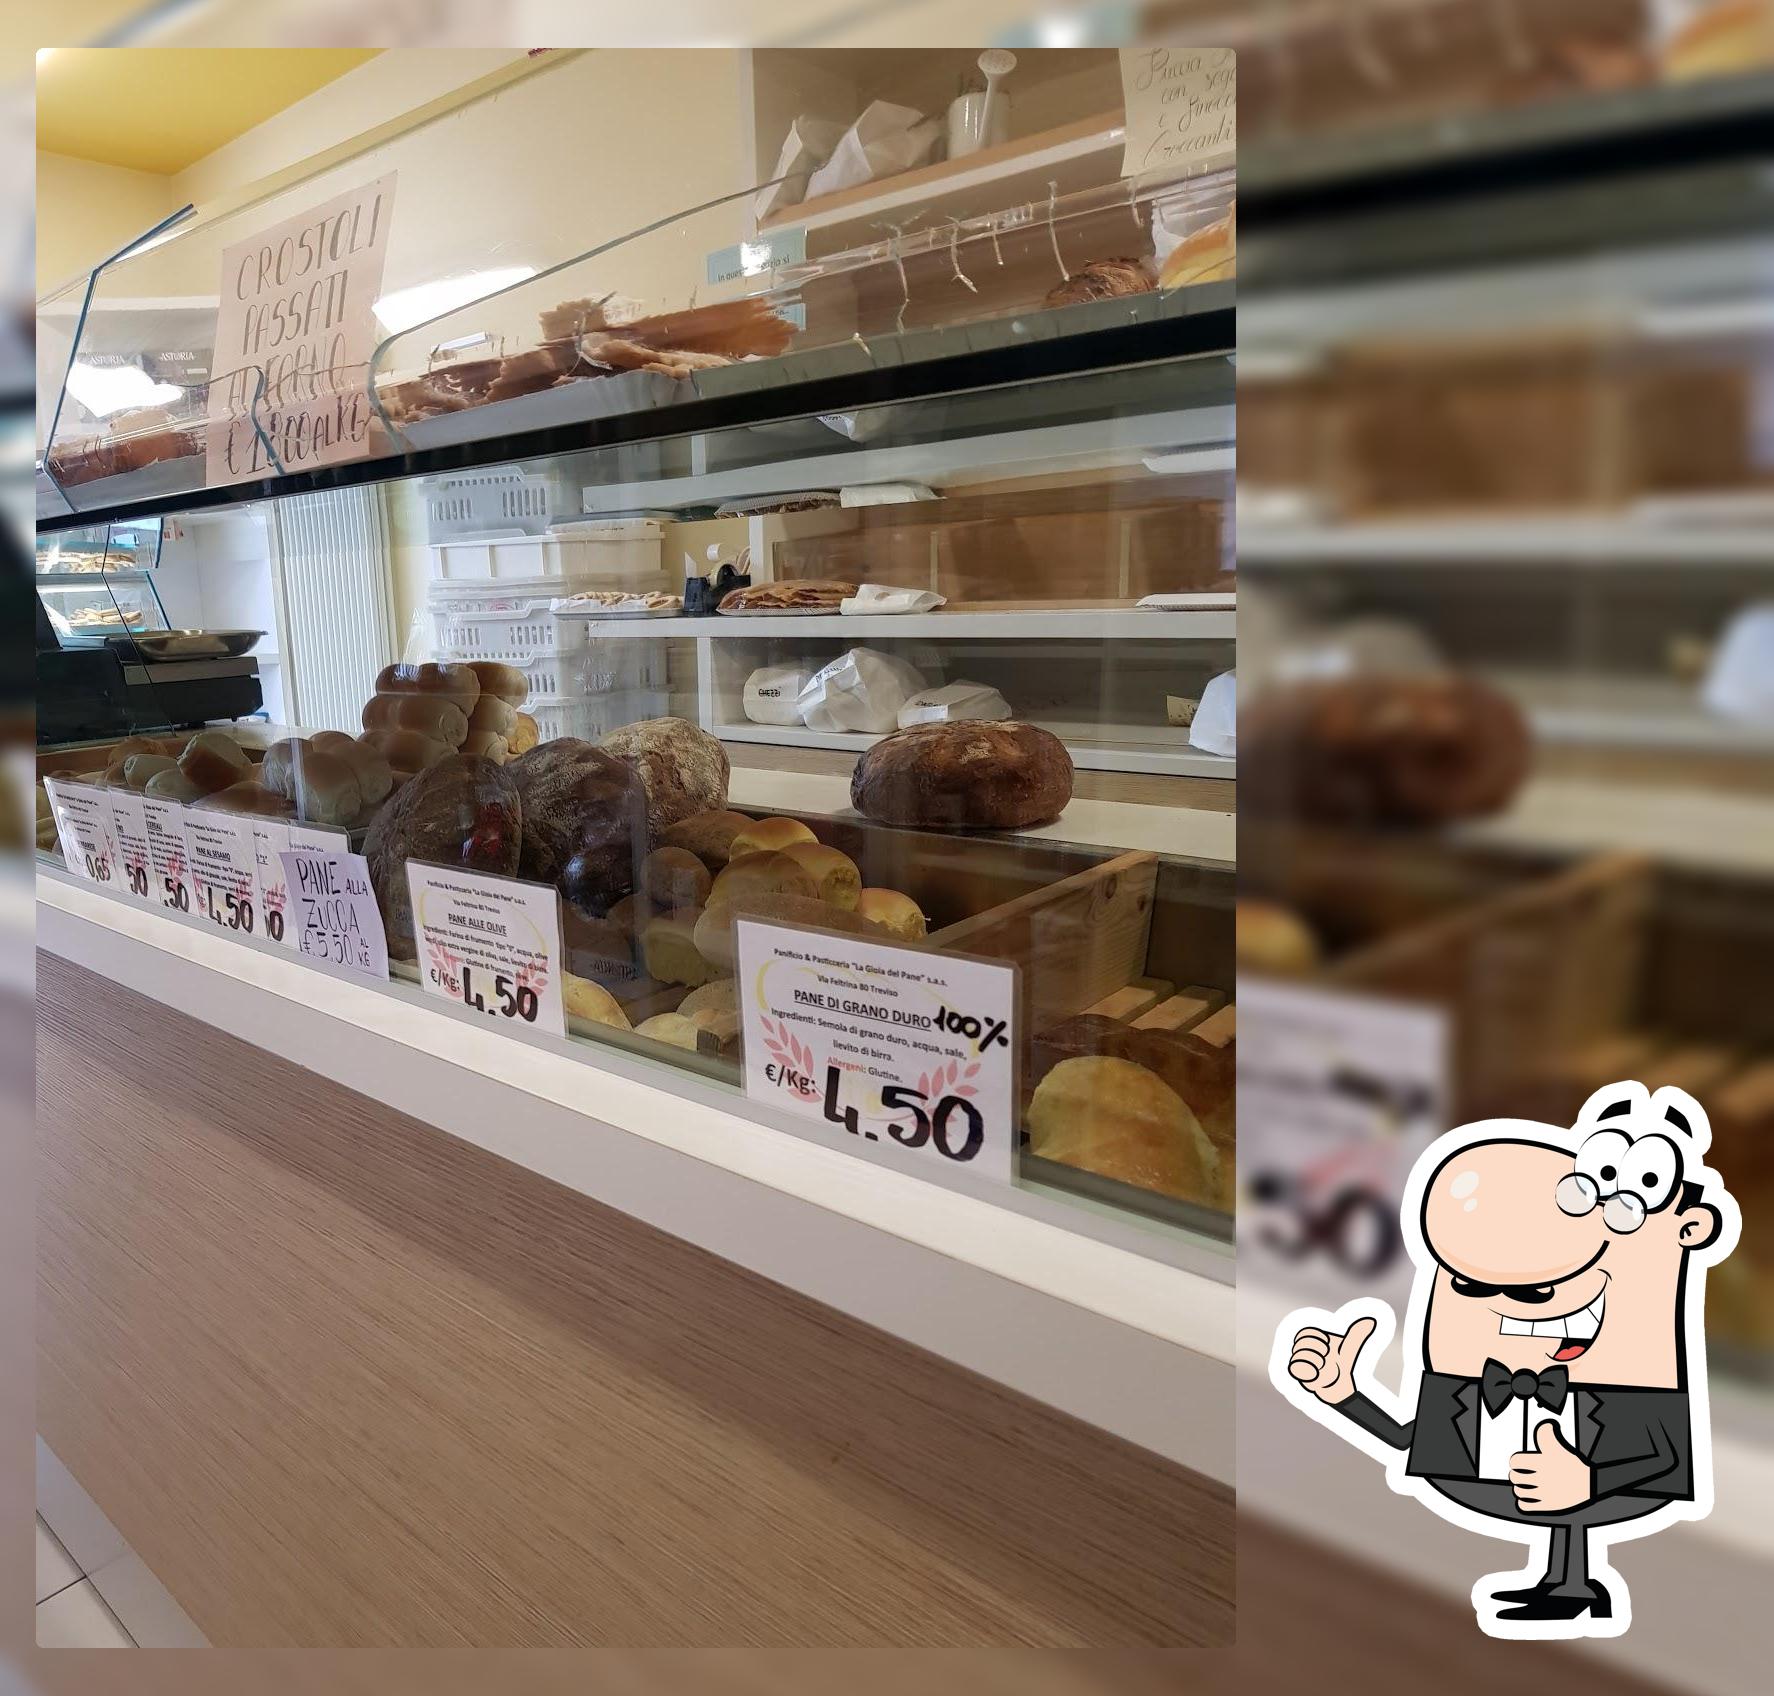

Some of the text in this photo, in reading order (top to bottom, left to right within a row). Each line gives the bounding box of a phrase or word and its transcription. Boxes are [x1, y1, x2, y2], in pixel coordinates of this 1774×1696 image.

[237, 194, 382, 301] CROSTOLI
[243, 270, 348, 355] PASSATI
[160, 351, 195, 361] ASTURIA
[86, 853, 111, 883] 0,65
[212, 849, 231, 861] SESAMO
[296, 858, 341, 896] PANE
[345, 877, 369, 897] ALLA
[207, 885, 254, 934] 4.50
[302, 898, 360, 934] ZUCCA
[448, 913, 507, 935] PANE ALLE OLIVE
[461, 946, 478, 955] vergine
[774, 948, 948, 987] Panificio & Pasticceria "La Gioia del Pane" s.a.s.
[431, 967, 460, 993] €/Kg:
[462, 966, 539, 1023] 4.50
[817, 974, 898, 997] Via Feltrina 80 Treviso
[771, 1007, 968, 1060] Ingredienti: Semola di grano duro, acqua, sale,
[794, 989, 1009, 1052] PANE DI GRANO DURO 100%
[832, 1040, 895, 1062] lievito di birra.
[765, 1063, 816, 1095] €/Kg:
[827, 1056, 903, 1083] Allergeni: Glutine.
[824, 1066, 984, 1162] 4.50
